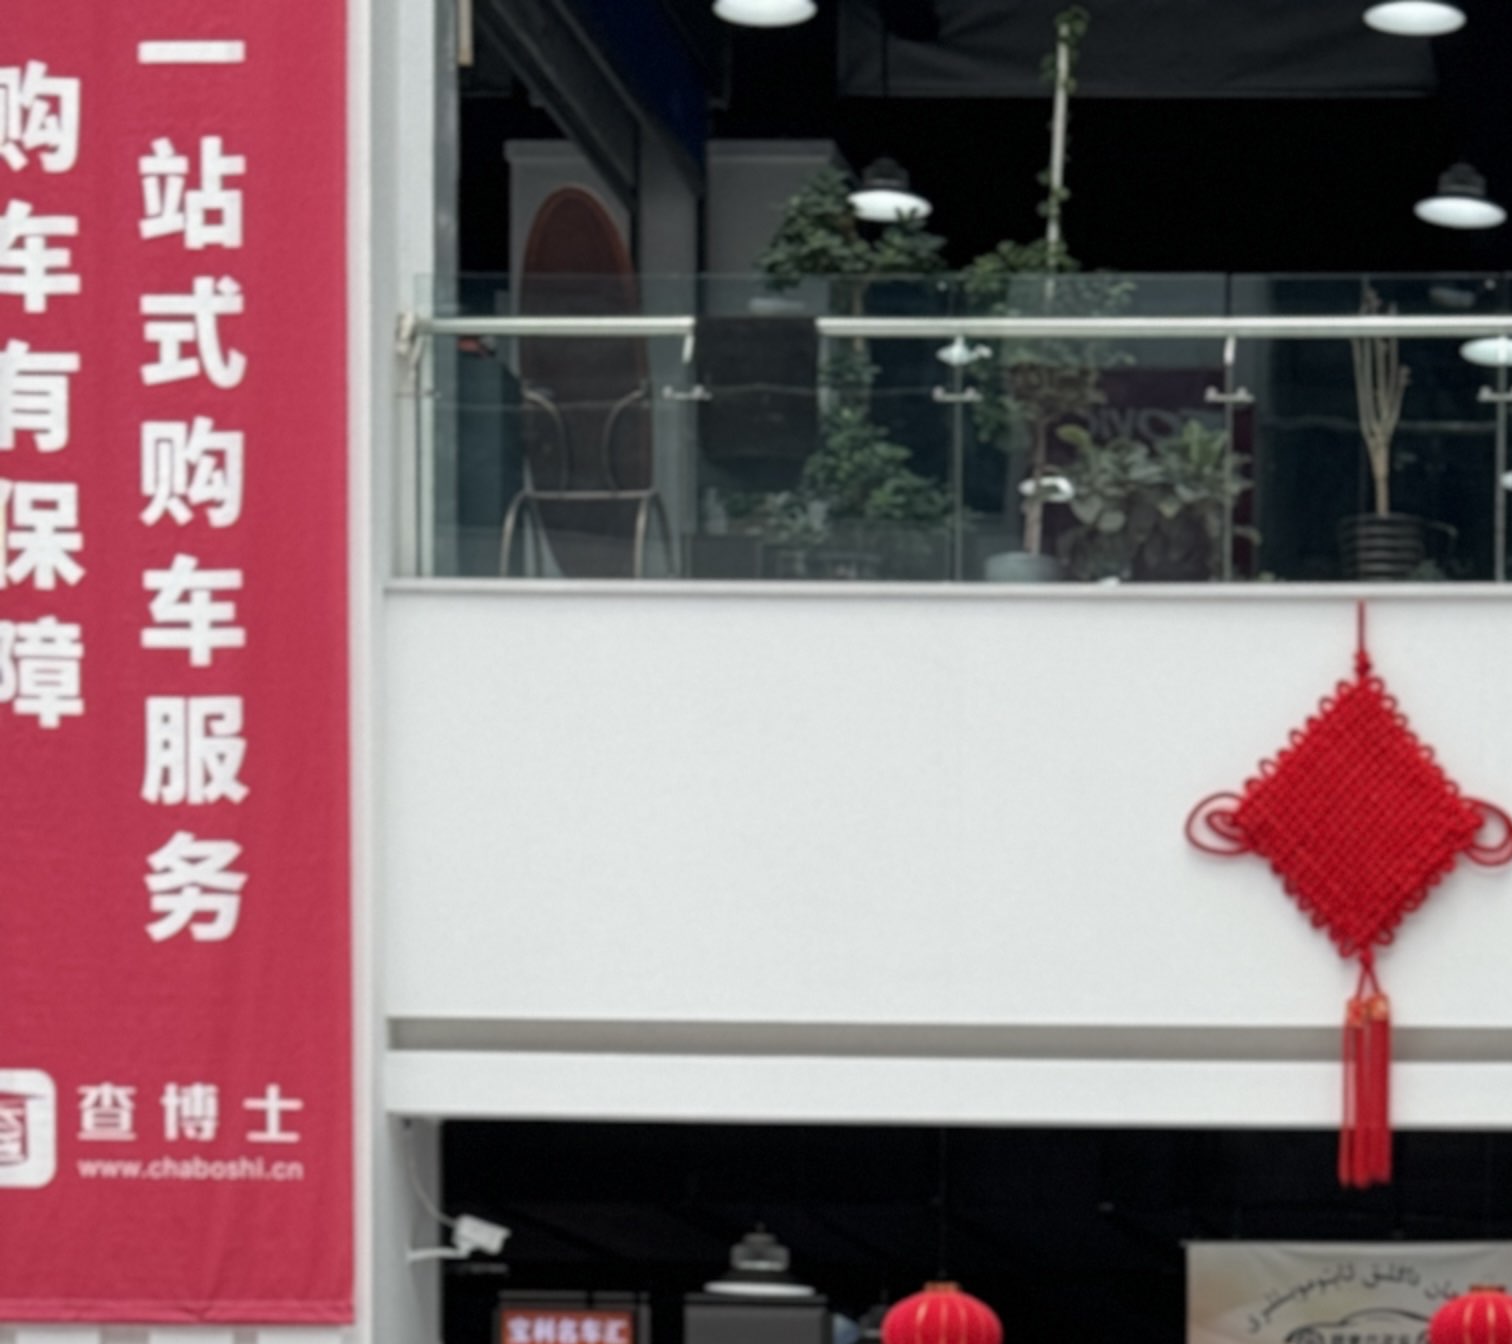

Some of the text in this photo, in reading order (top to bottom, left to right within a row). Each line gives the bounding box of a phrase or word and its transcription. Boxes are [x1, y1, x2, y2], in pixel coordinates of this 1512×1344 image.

[0, 60, 85, 729] 购车有保障
[137, 40, 248, 942] 一站式购车服务
[76, 1156, 304, 1181] www.chaboshi.cn
[77, 1083, 304, 1142] 查博士
